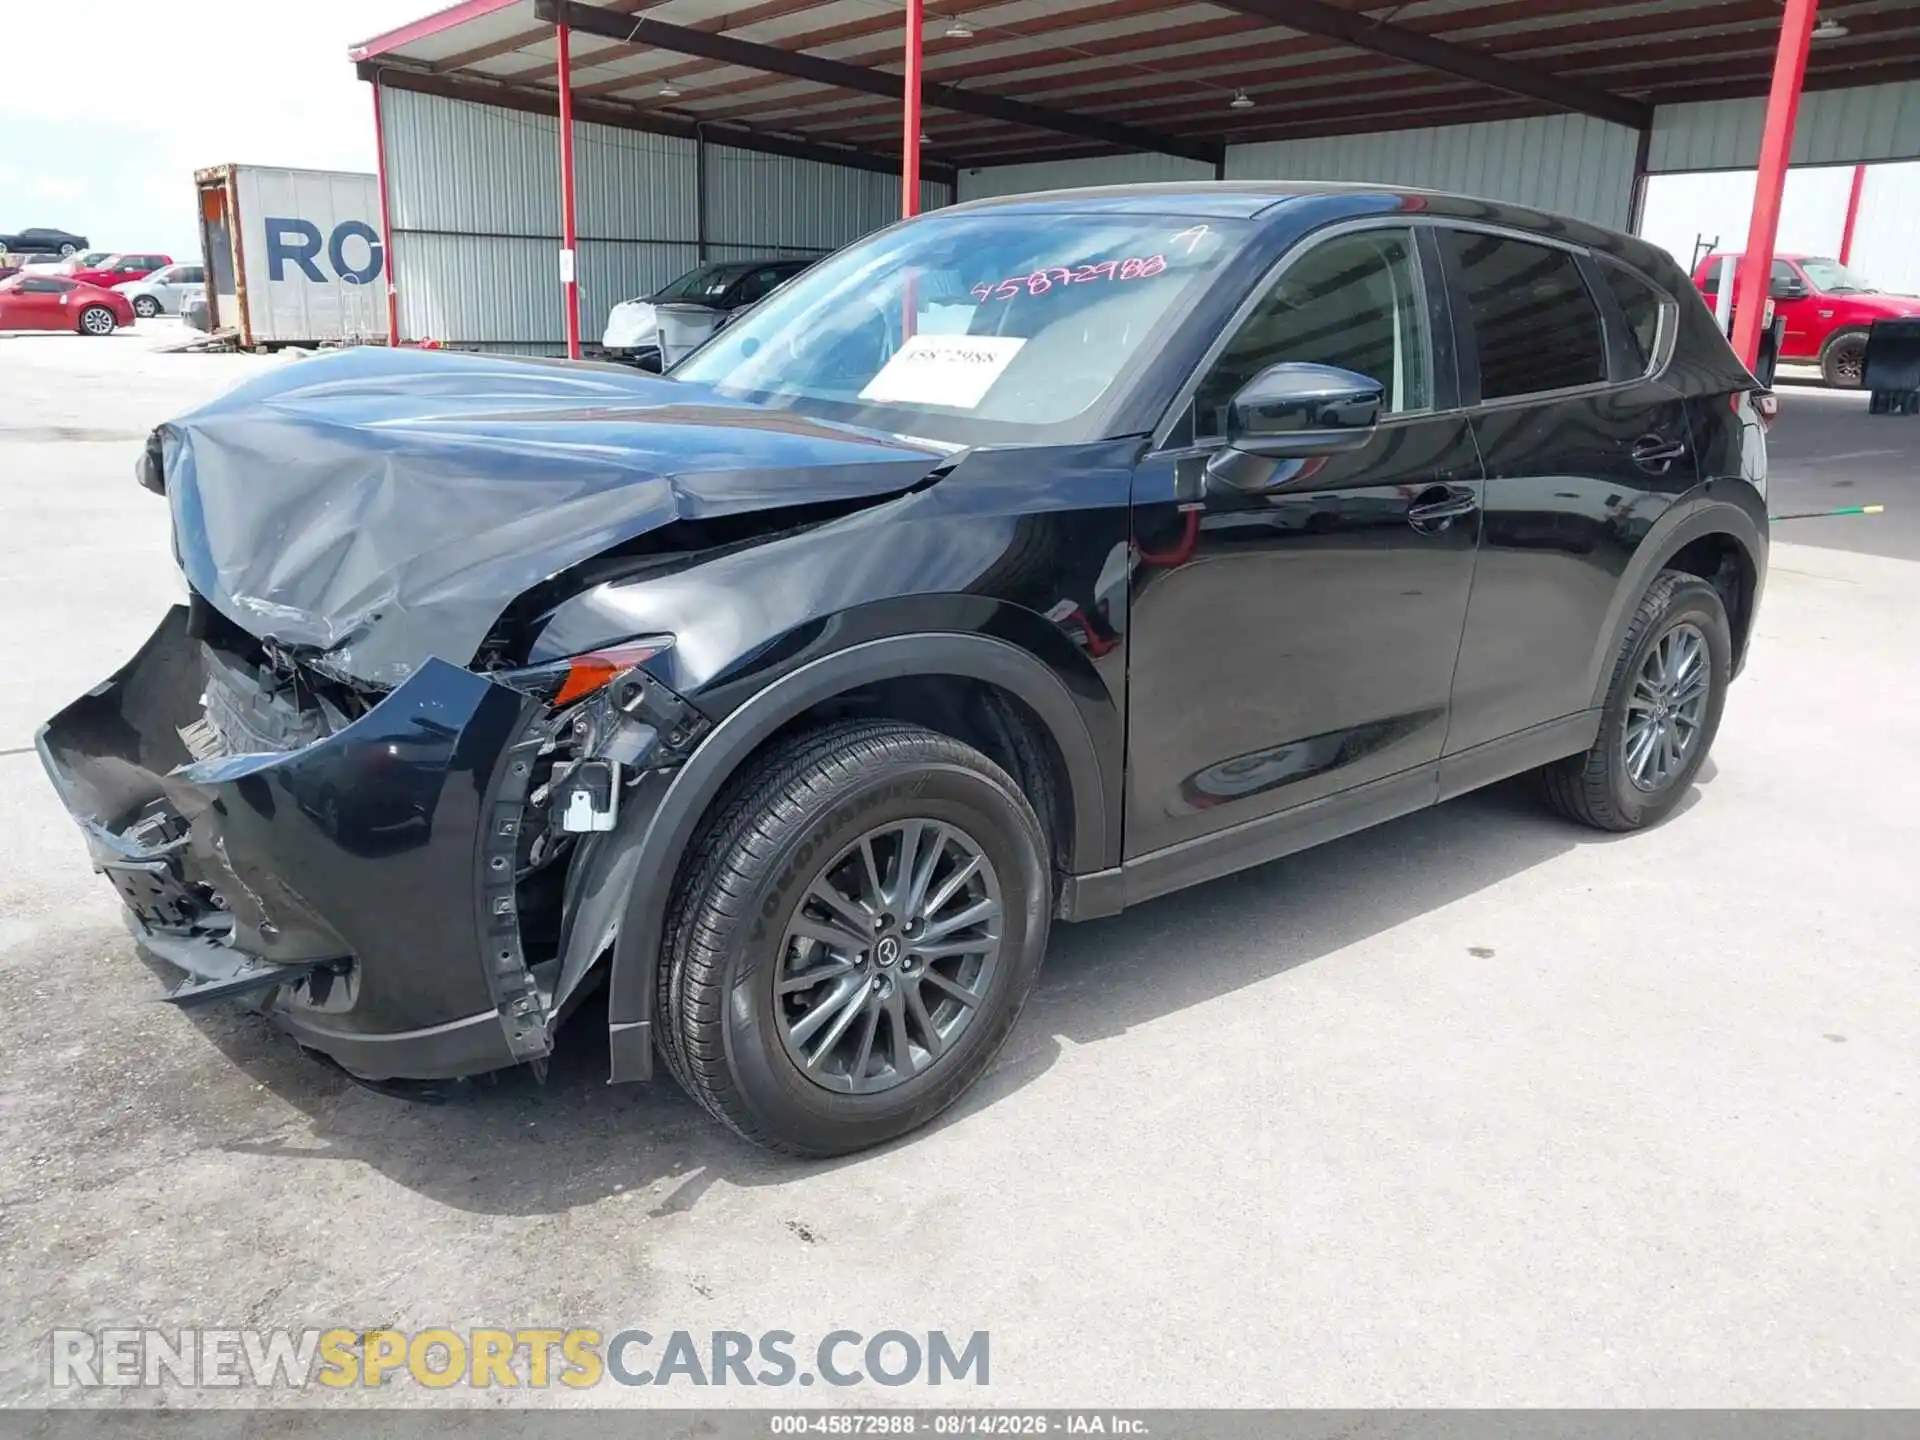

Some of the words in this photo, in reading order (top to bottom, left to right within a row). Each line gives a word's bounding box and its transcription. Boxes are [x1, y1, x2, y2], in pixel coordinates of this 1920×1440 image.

[264, 216, 384, 285] RO
[970, 253, 1167, 302] 45872988
[749, 784, 905, 942] YOKOH
